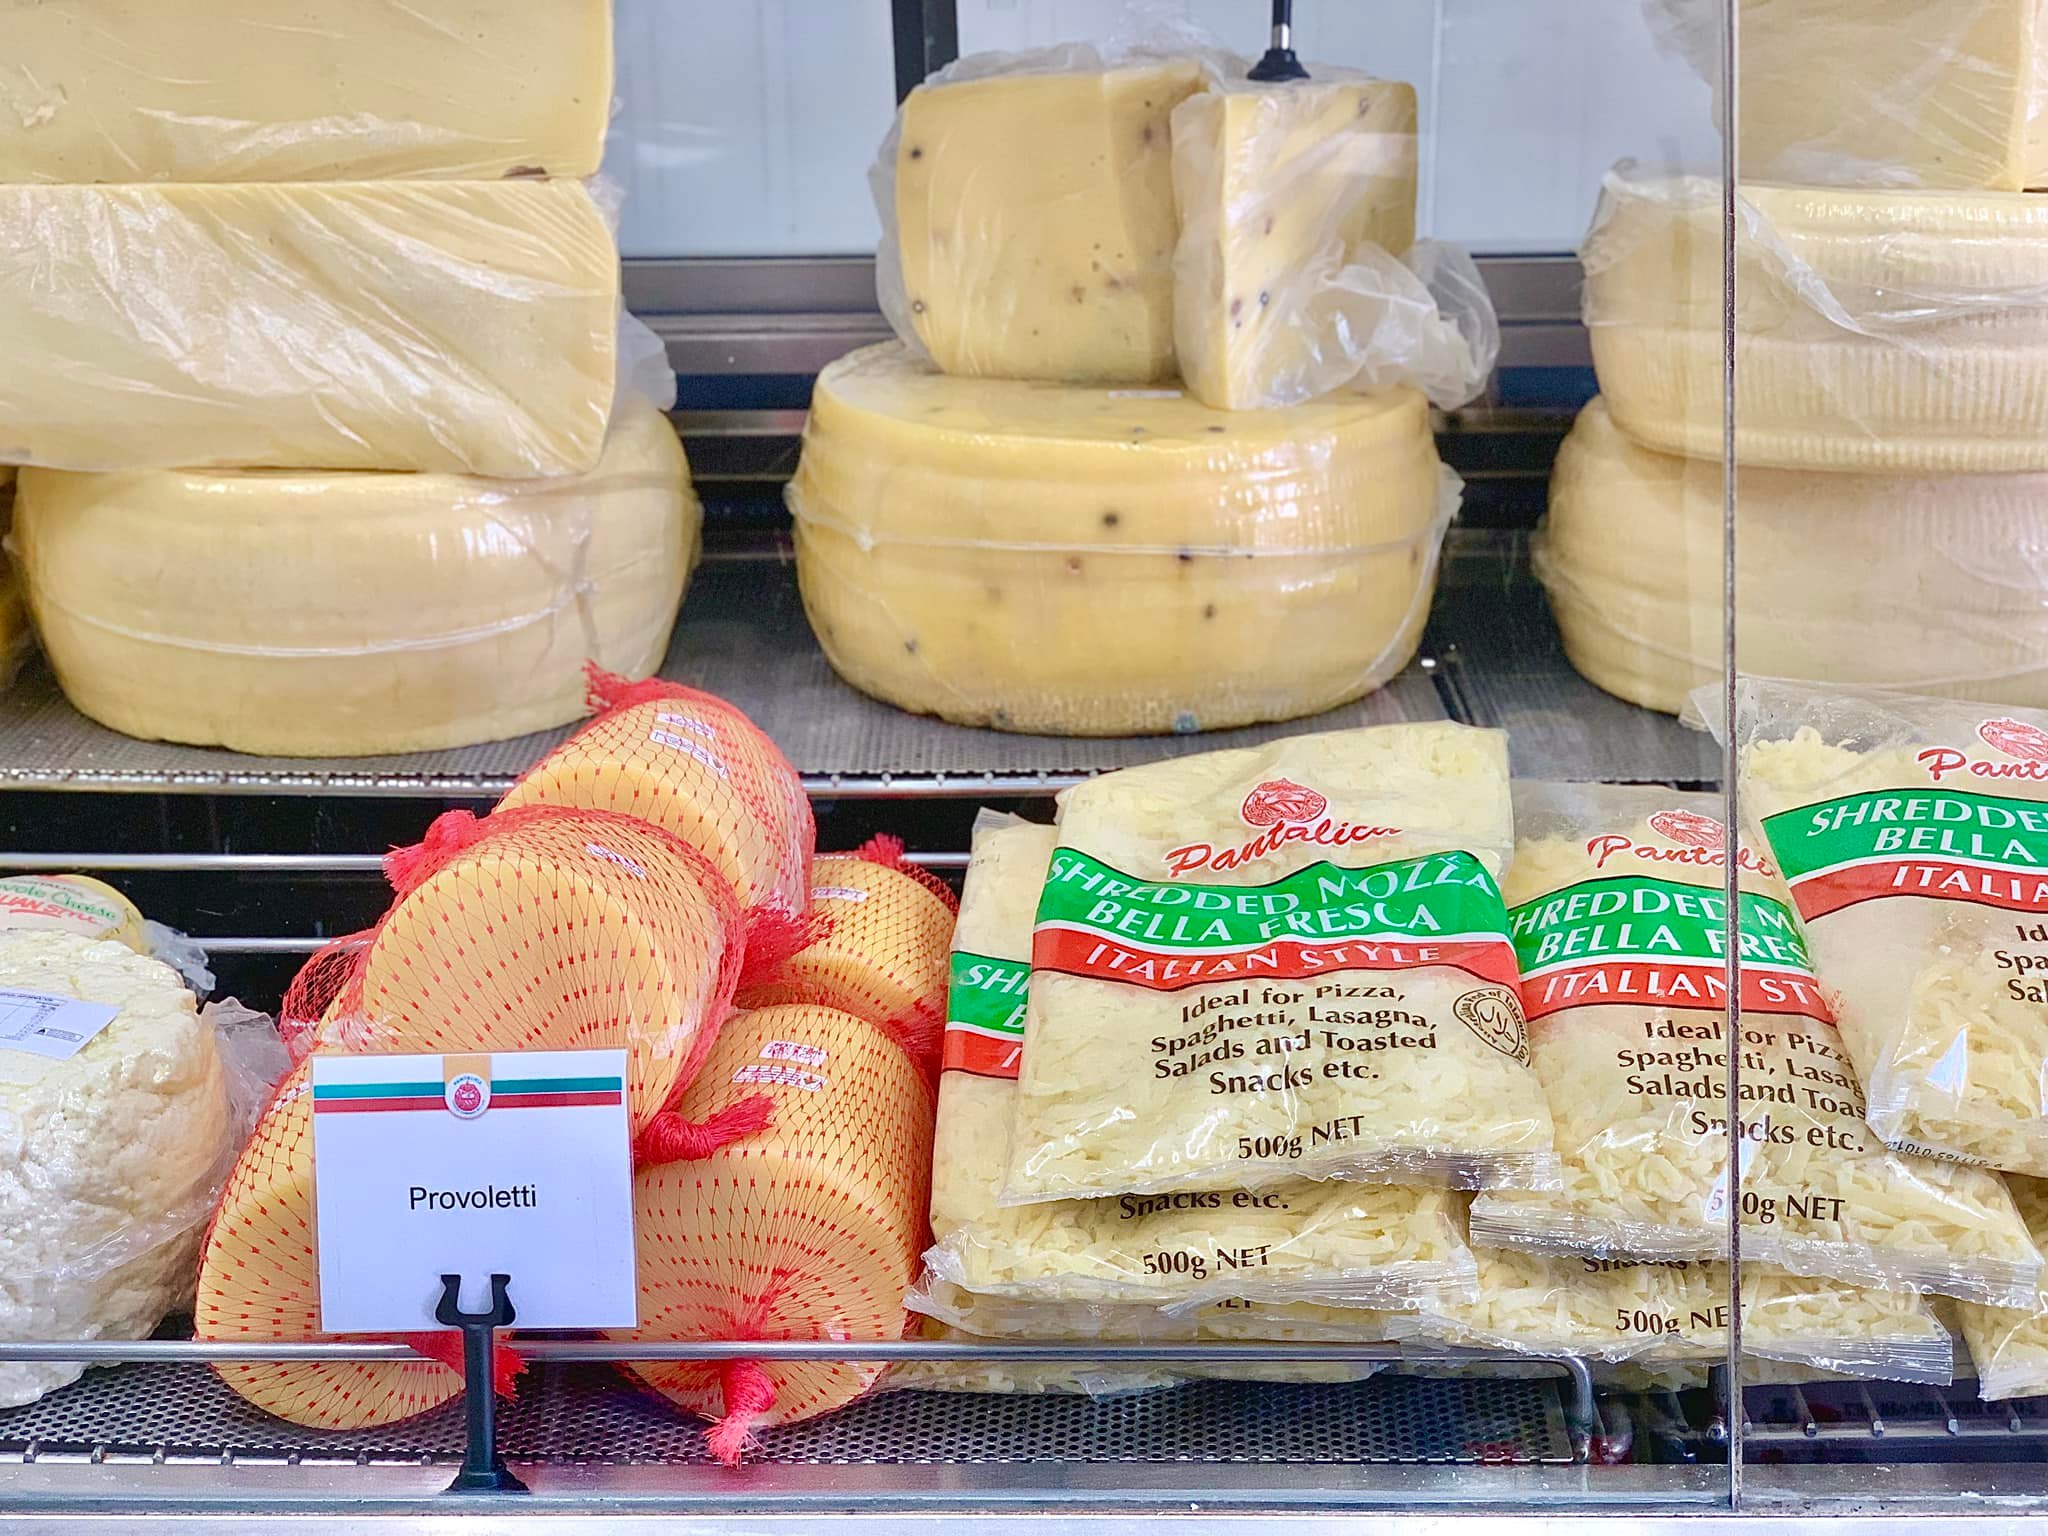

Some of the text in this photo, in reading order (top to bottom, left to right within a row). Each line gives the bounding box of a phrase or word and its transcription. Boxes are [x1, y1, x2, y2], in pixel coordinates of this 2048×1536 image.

[1165, 818, 1403, 878] Pantalica
[1587, 835, 1776, 879] Pantali
[1873, 827, 2038, 863] BELLA
[1046, 854, 1496, 915] SHREDDED MOZZA
[1085, 899, 1441, 942] BELLA FRESCA
[1508, 888, 1726, 938] HREDDED
[1085, 943, 1441, 980] ITALIAN STYLE
[1534, 923, 1683, 965] BELLA
[1182, 983, 1406, 1023] Ideal for Pizza,
[1150, 1005, 1438, 1057] Spaghetti, Lasagna,
[1644, 1019, 1722, 1040] Ideal
[1738, 1022, 1777, 1047] or
[1154, 1029, 1438, 1079] Salads and Toasted
[1617, 1046, 1776, 1076] Spagheti,
[1209, 1059, 1380, 1095] Snacks etc.
[1626, 1073, 1727, 1100] Salads
[1739, 1082, 1796, 1105] and
[1237, 1115, 1366, 1160] 500g NET
[1806, 1122, 1865, 1153] etc.
[409, 1183, 537, 1210] Provoletti
[1119, 1191, 1289, 1220] Snacks etc.
[1710, 1188, 1846, 1225] 50g NET
[1142, 1244, 1272, 1280] 500g NET
[1615, 1303, 1747, 1335] 500g NE
